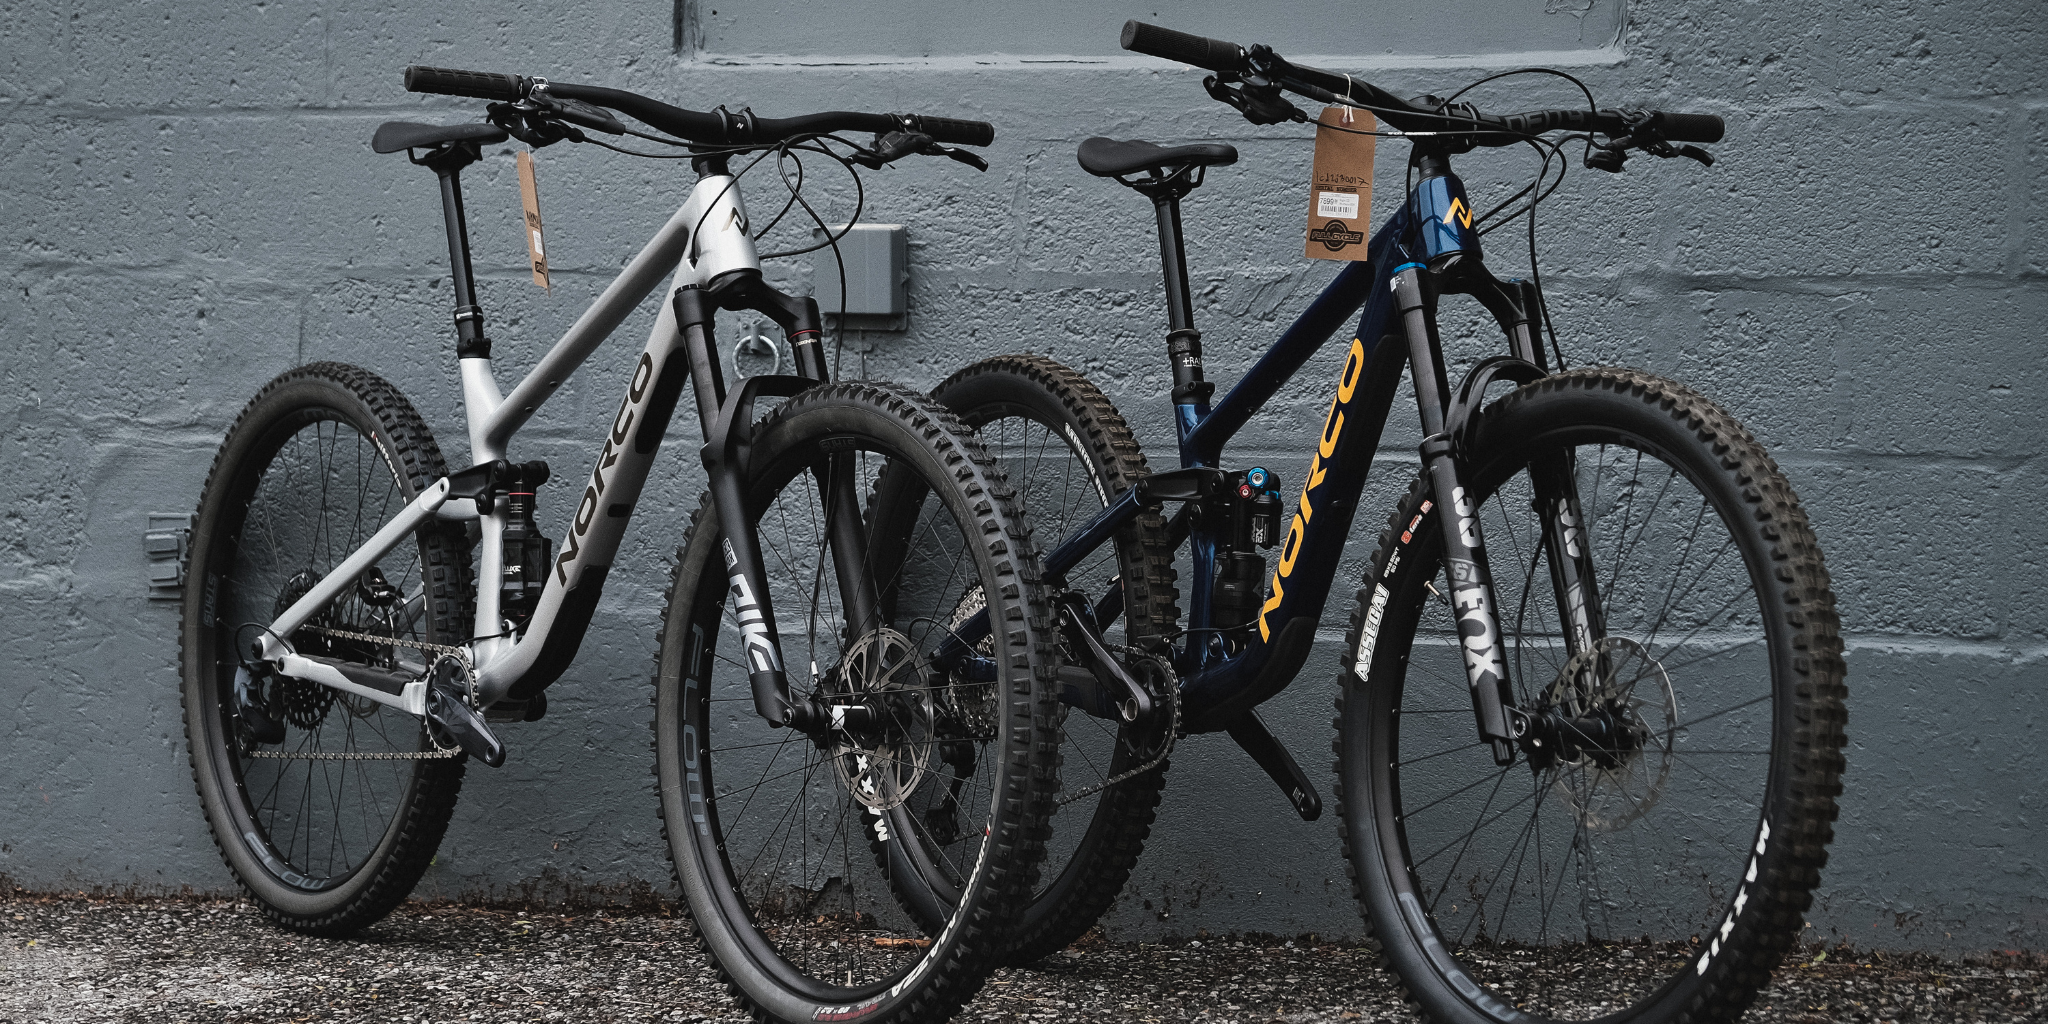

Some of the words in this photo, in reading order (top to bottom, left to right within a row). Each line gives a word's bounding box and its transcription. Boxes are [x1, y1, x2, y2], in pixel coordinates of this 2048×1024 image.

[558, 352, 653, 587] NORCO
[1259, 338, 1365, 643] NORCO
[729, 573, 783, 674] PIKE
[1354, 582, 1390, 683] ASSEGAI
[1454, 583, 1504, 688] FOX
[683, 622, 705, 826] FLOW
[244, 831, 326, 890] FLOW
[1696, 817, 1772, 977] MAXXIS
[1398, 891, 1520, 1022] FLOW
